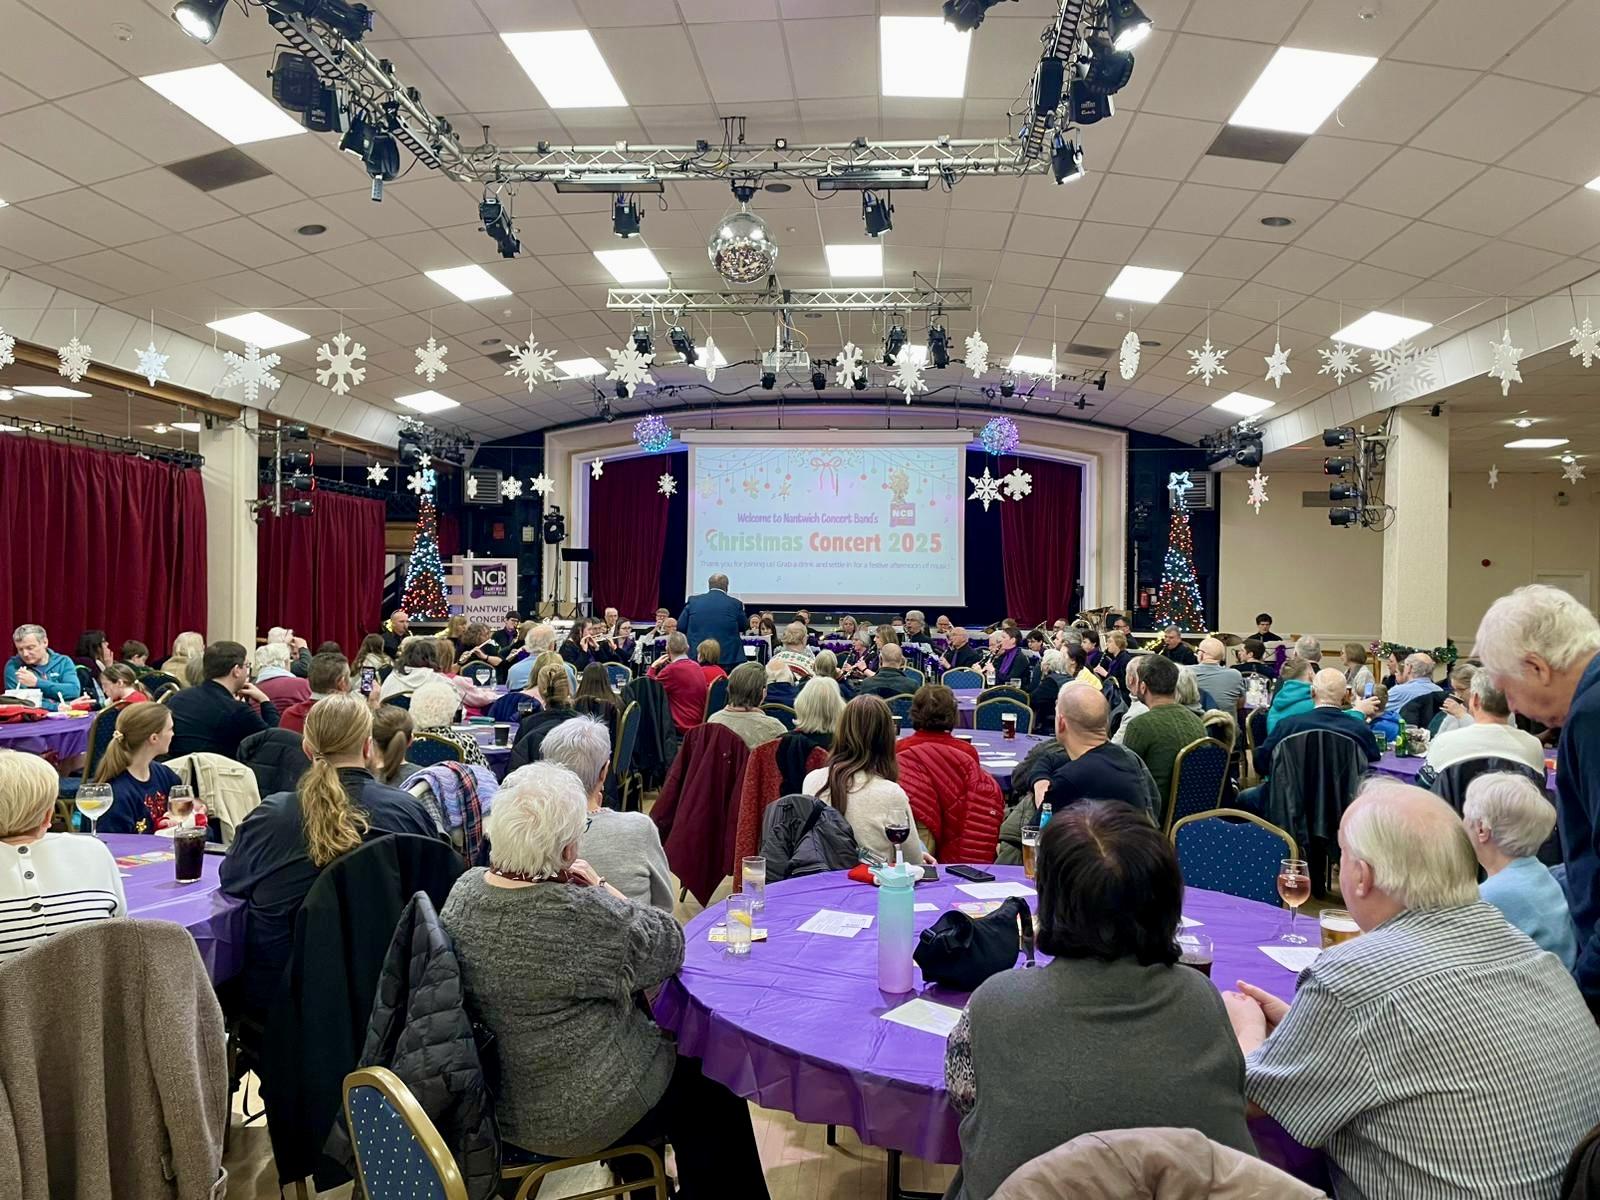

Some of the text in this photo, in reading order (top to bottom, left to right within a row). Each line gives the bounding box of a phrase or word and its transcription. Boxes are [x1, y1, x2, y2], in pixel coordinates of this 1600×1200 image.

[737, 512, 879, 524] Welcome to Nantwich Concert Band's
[892, 509, 914, 518] NCB
[708, 532, 942, 553] Christmas Concert 2025
[474, 571, 506, 585] NCB
[466, 605, 514, 613] NANTWICH
[469, 615, 507, 624] CONCER
